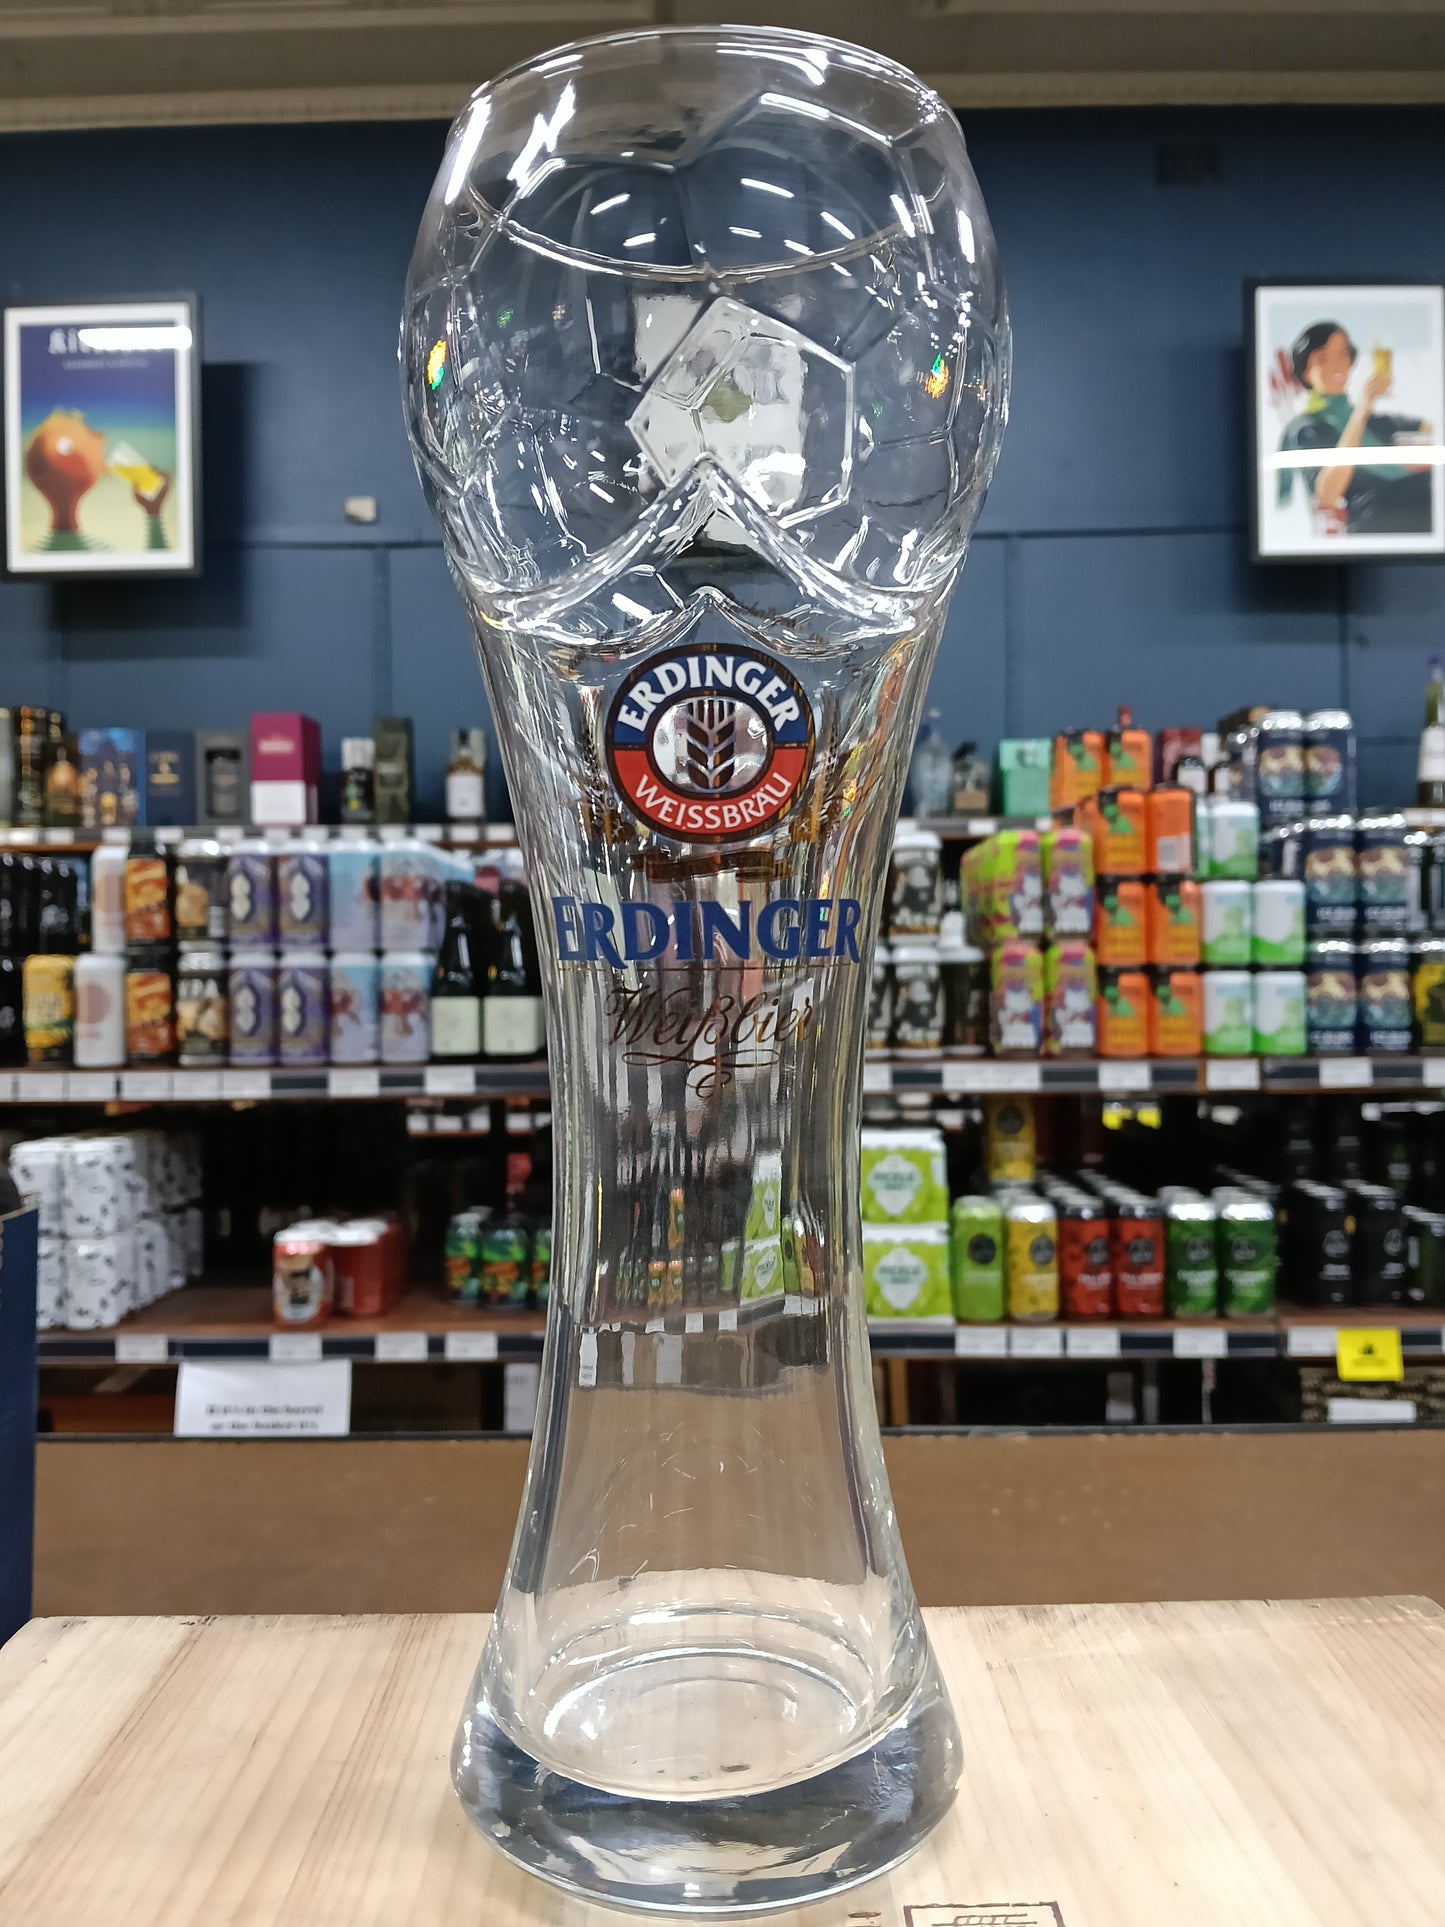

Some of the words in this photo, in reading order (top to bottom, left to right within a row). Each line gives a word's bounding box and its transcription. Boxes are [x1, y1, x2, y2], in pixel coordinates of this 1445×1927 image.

[617, 654, 800, 732] ERDINGER
[634, 771, 793, 830] WEISSBRÄU
[551, 896, 861, 970] ERDINGER
[604, 984, 814, 1067] Weißbier
